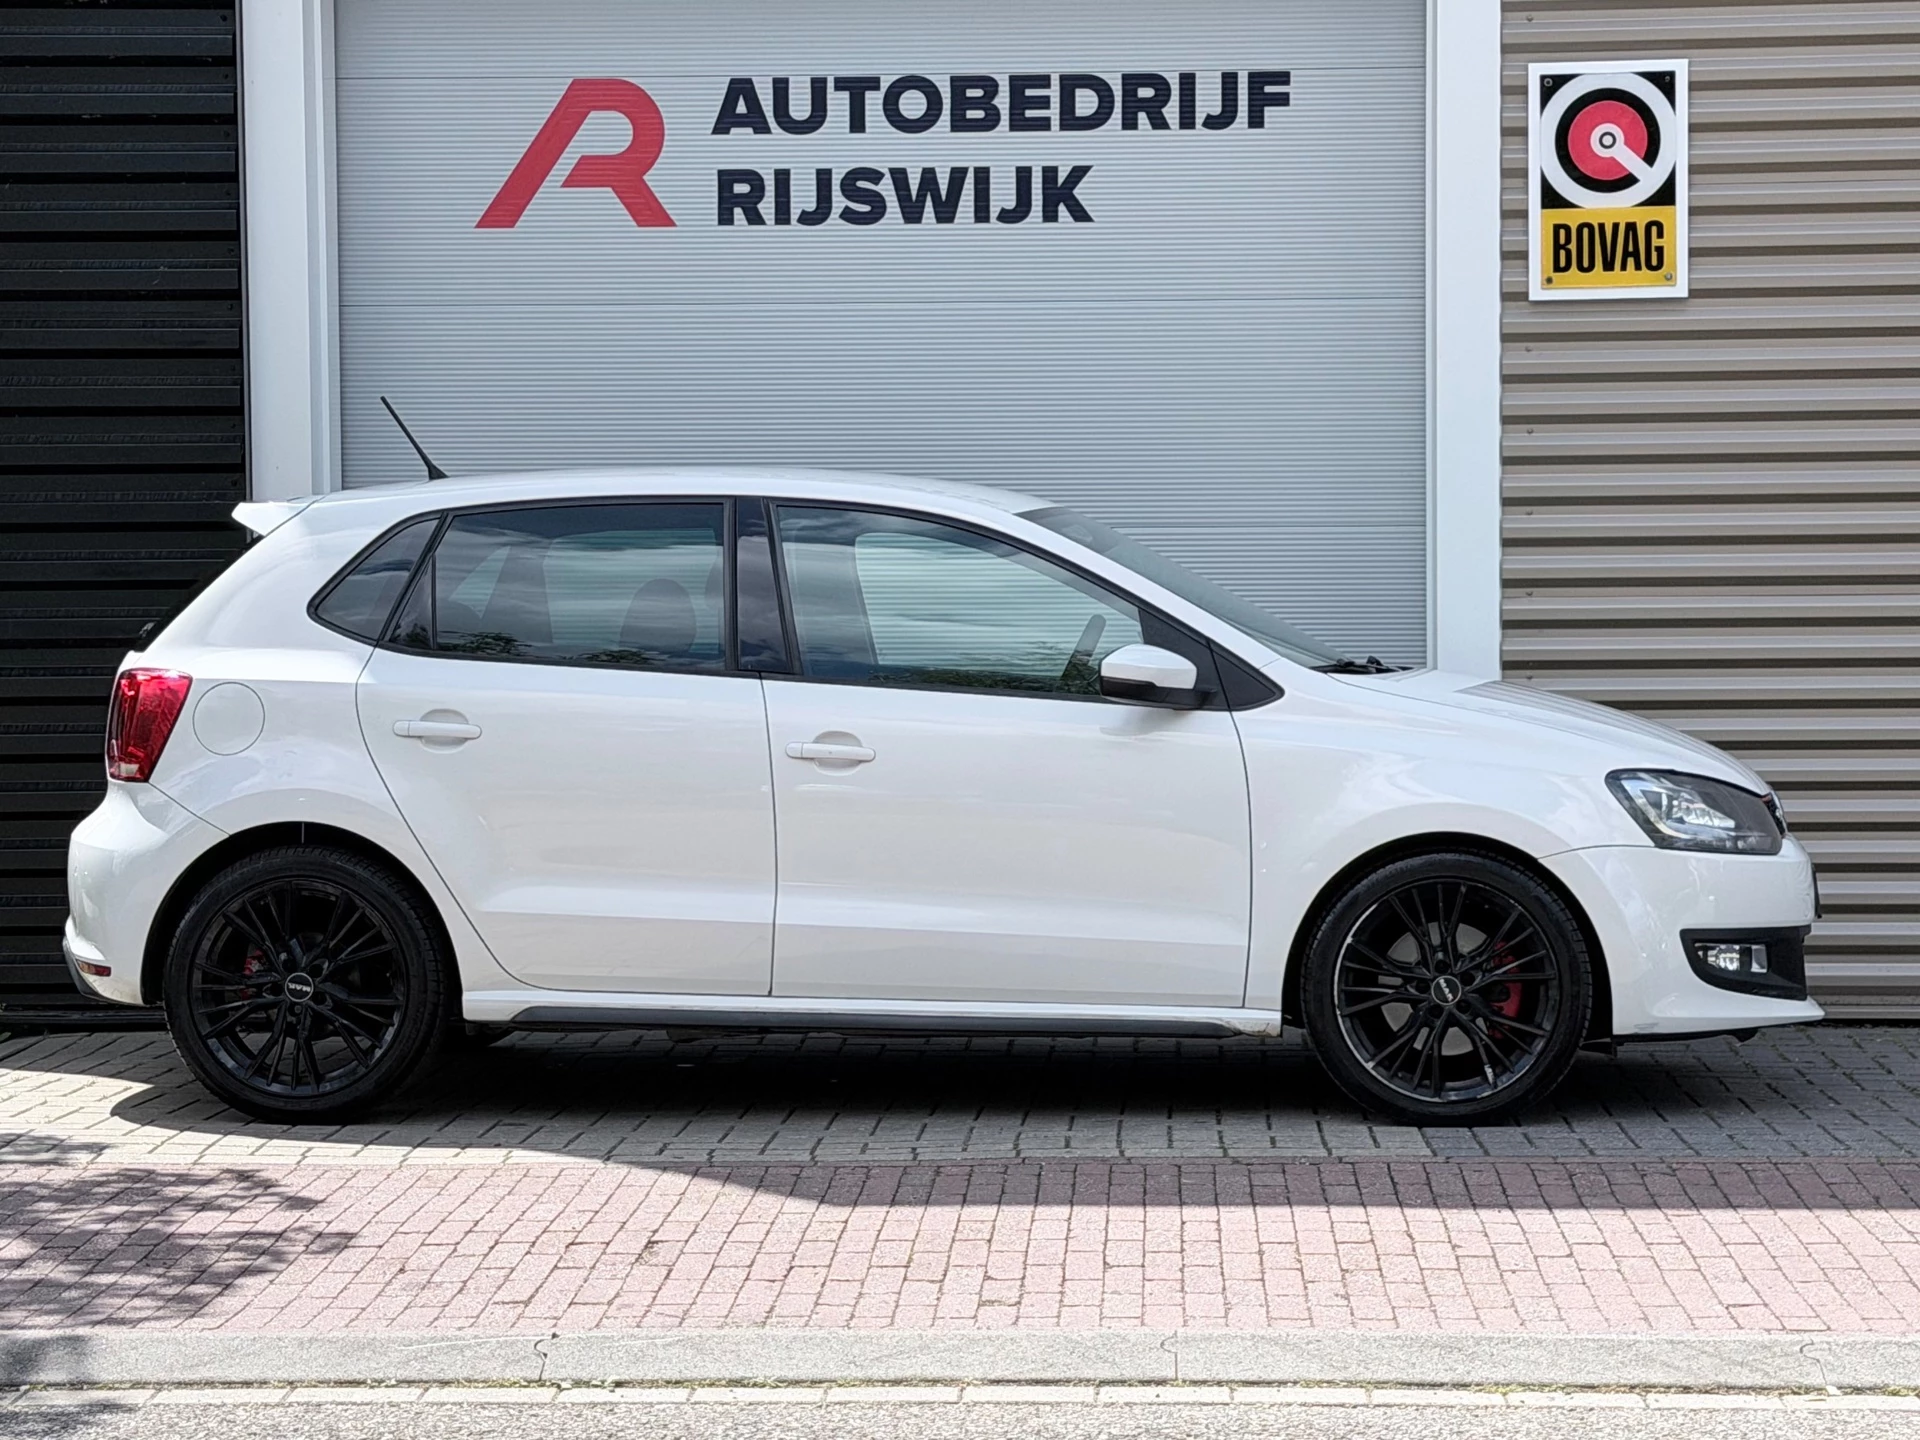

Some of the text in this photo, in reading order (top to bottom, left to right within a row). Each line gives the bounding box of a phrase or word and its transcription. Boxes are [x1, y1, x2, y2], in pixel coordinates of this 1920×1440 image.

[711, 70, 1291, 136] AUTOBEDRIJF
[717, 165, 1095, 227] RIJSWIJK
[1552, 219, 1666, 274] BOVAG
